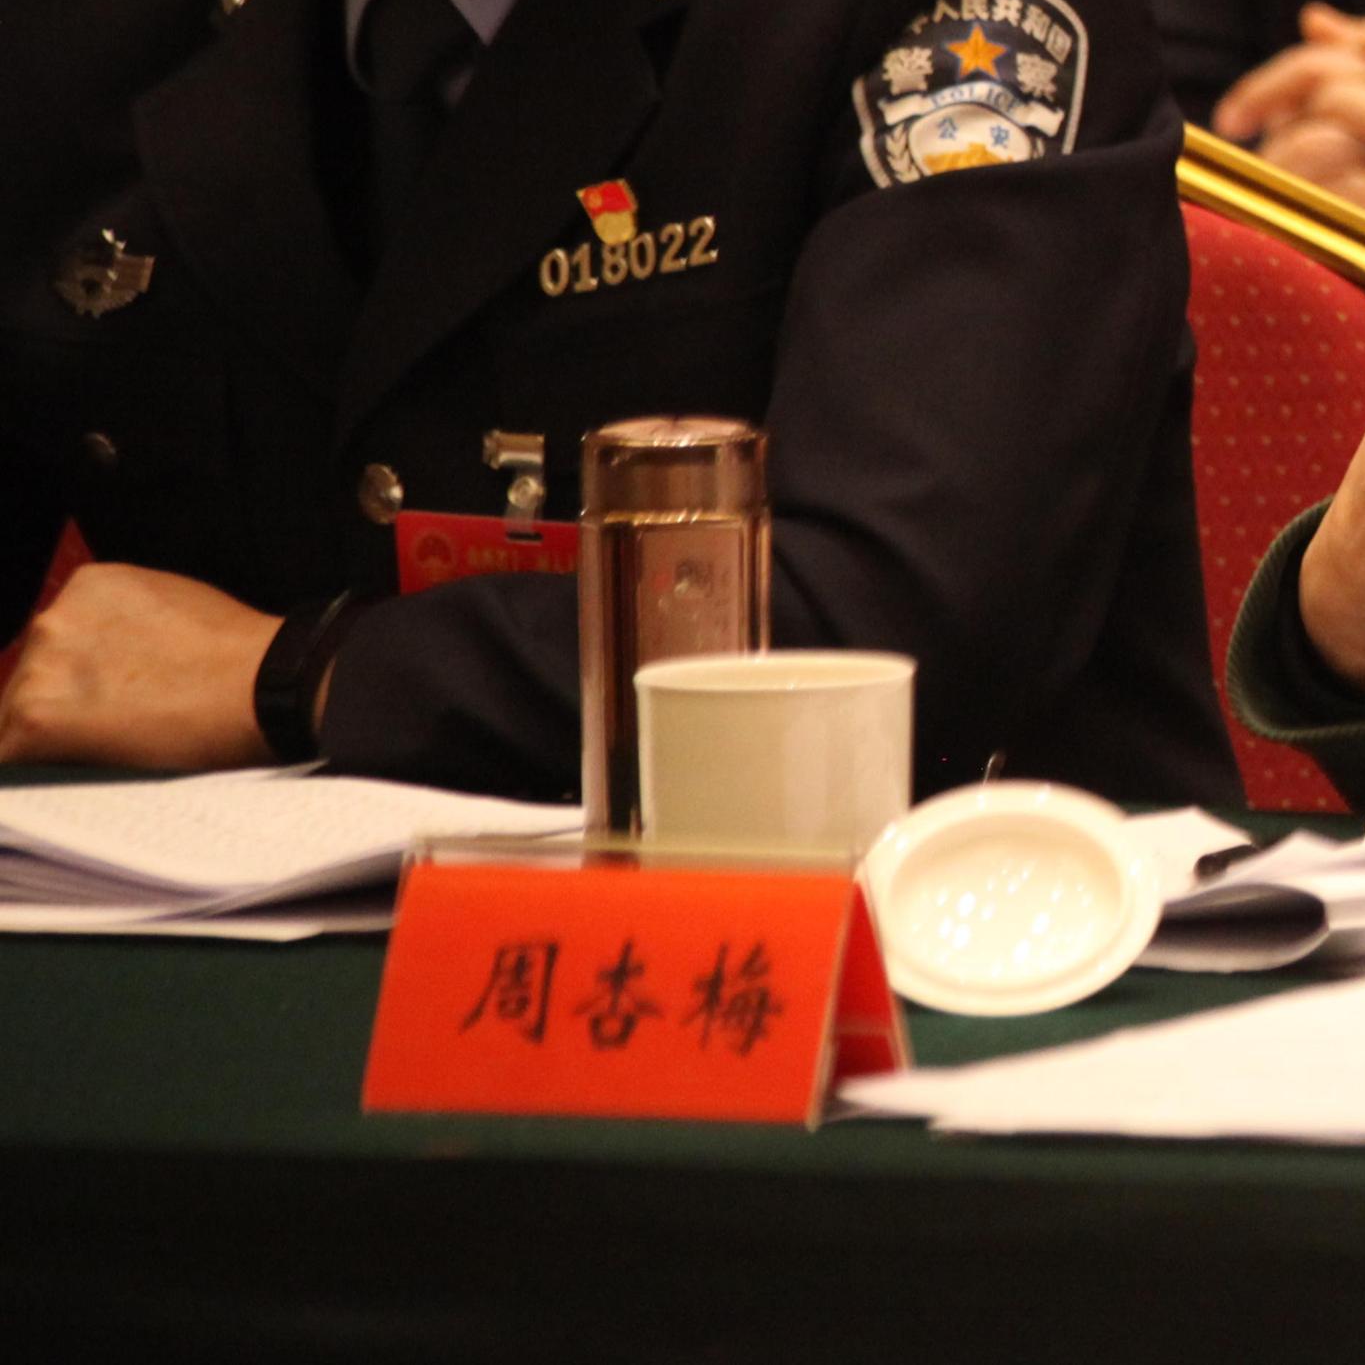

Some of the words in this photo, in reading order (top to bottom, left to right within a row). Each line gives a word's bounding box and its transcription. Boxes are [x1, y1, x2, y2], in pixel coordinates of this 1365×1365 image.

[539, 215, 720, 298] 018022
[458, 939, 783, 1058] 周杏梅
